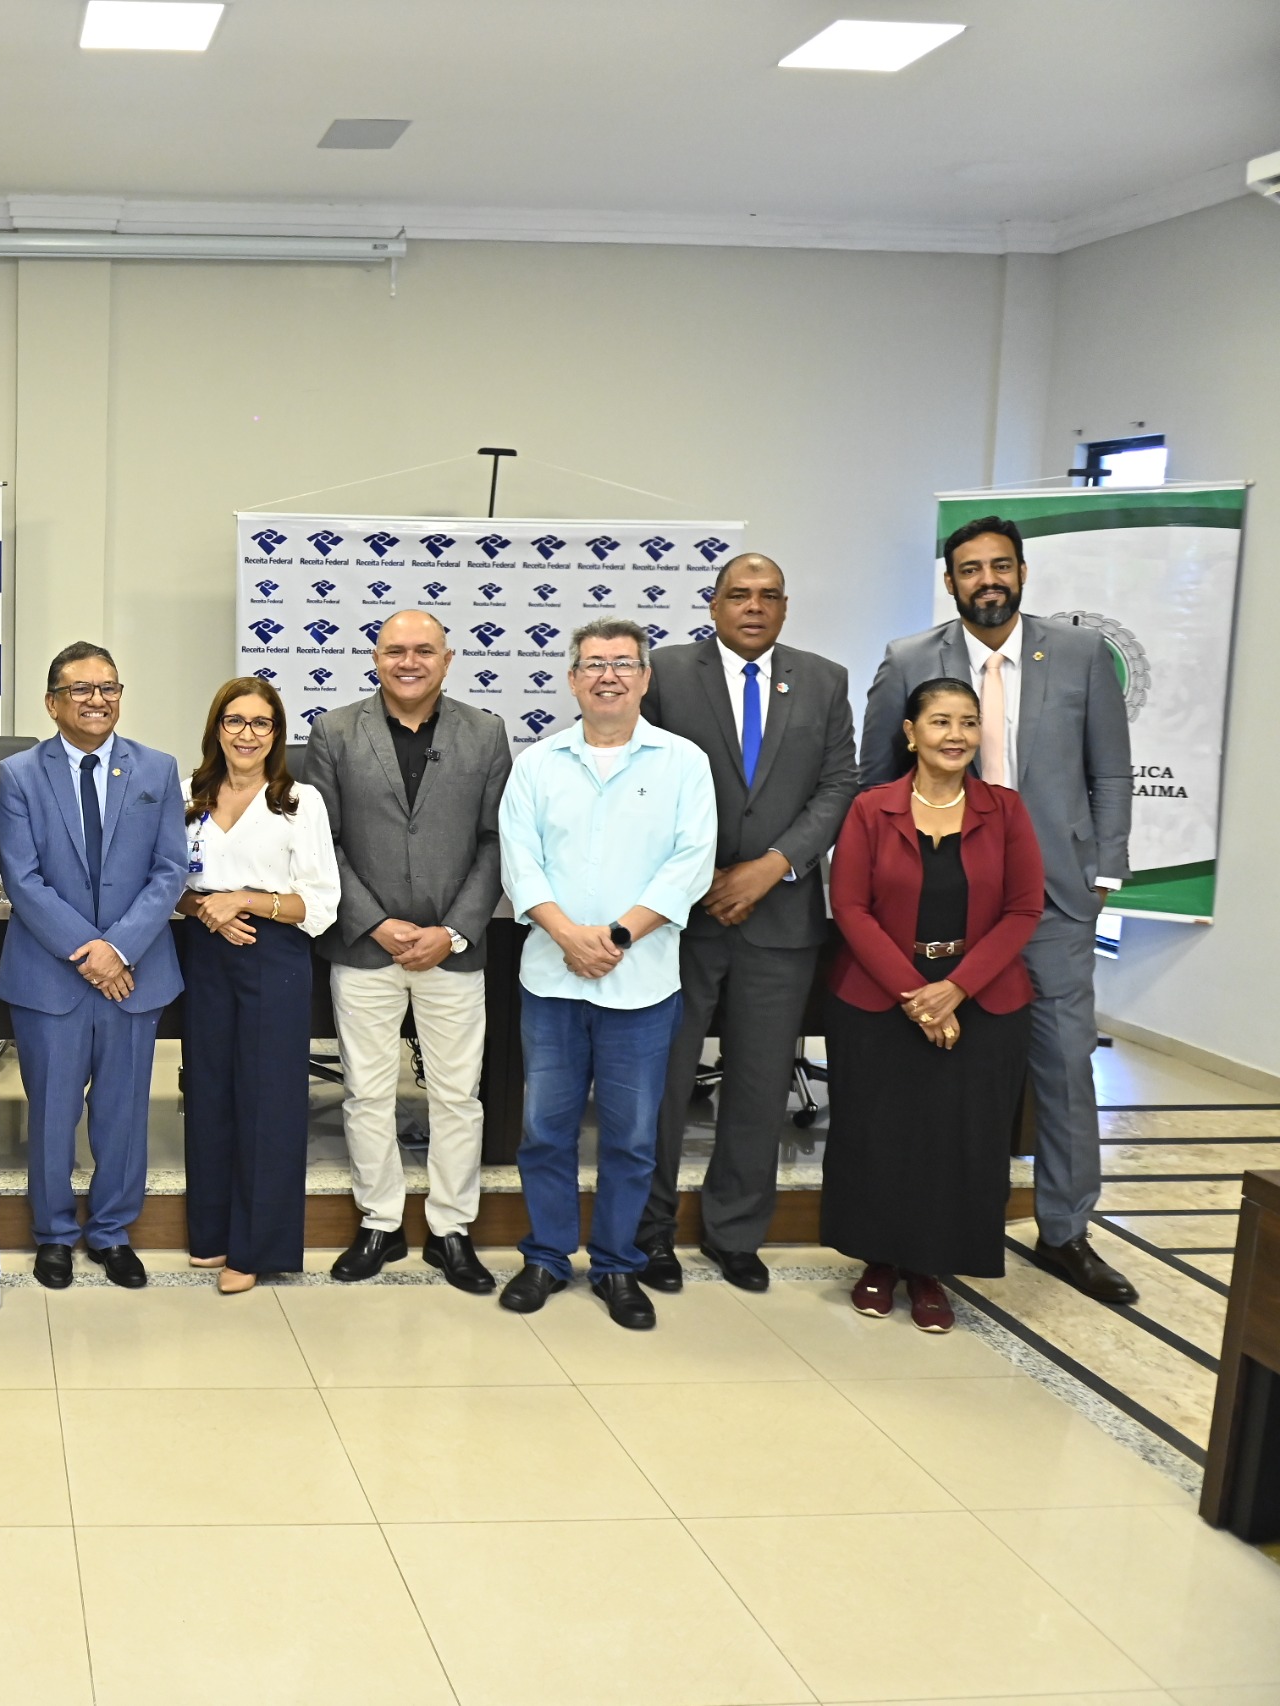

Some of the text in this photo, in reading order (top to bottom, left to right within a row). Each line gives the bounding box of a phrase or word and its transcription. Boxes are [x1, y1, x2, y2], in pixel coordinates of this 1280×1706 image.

[244, 556, 292, 565] Receita Federal
[300, 557, 349, 565] Receita Federal
[356, 558, 405, 566] Receita Federal
[411, 560, 460, 568] Receita Federal
[577, 562, 625, 570] Receita Federal
[632, 563, 679, 571] Receita Federal
[686, 564, 710, 572] Receita
[241, 646, 289, 654] Receita Federal
[462, 648, 486, 656] Receita
[487, 648, 510, 656] Federal
[517, 649, 565, 657] Receita Federal
[1131, 766, 1174, 778] LICA
[1132, 784, 1188, 798] AIMA
